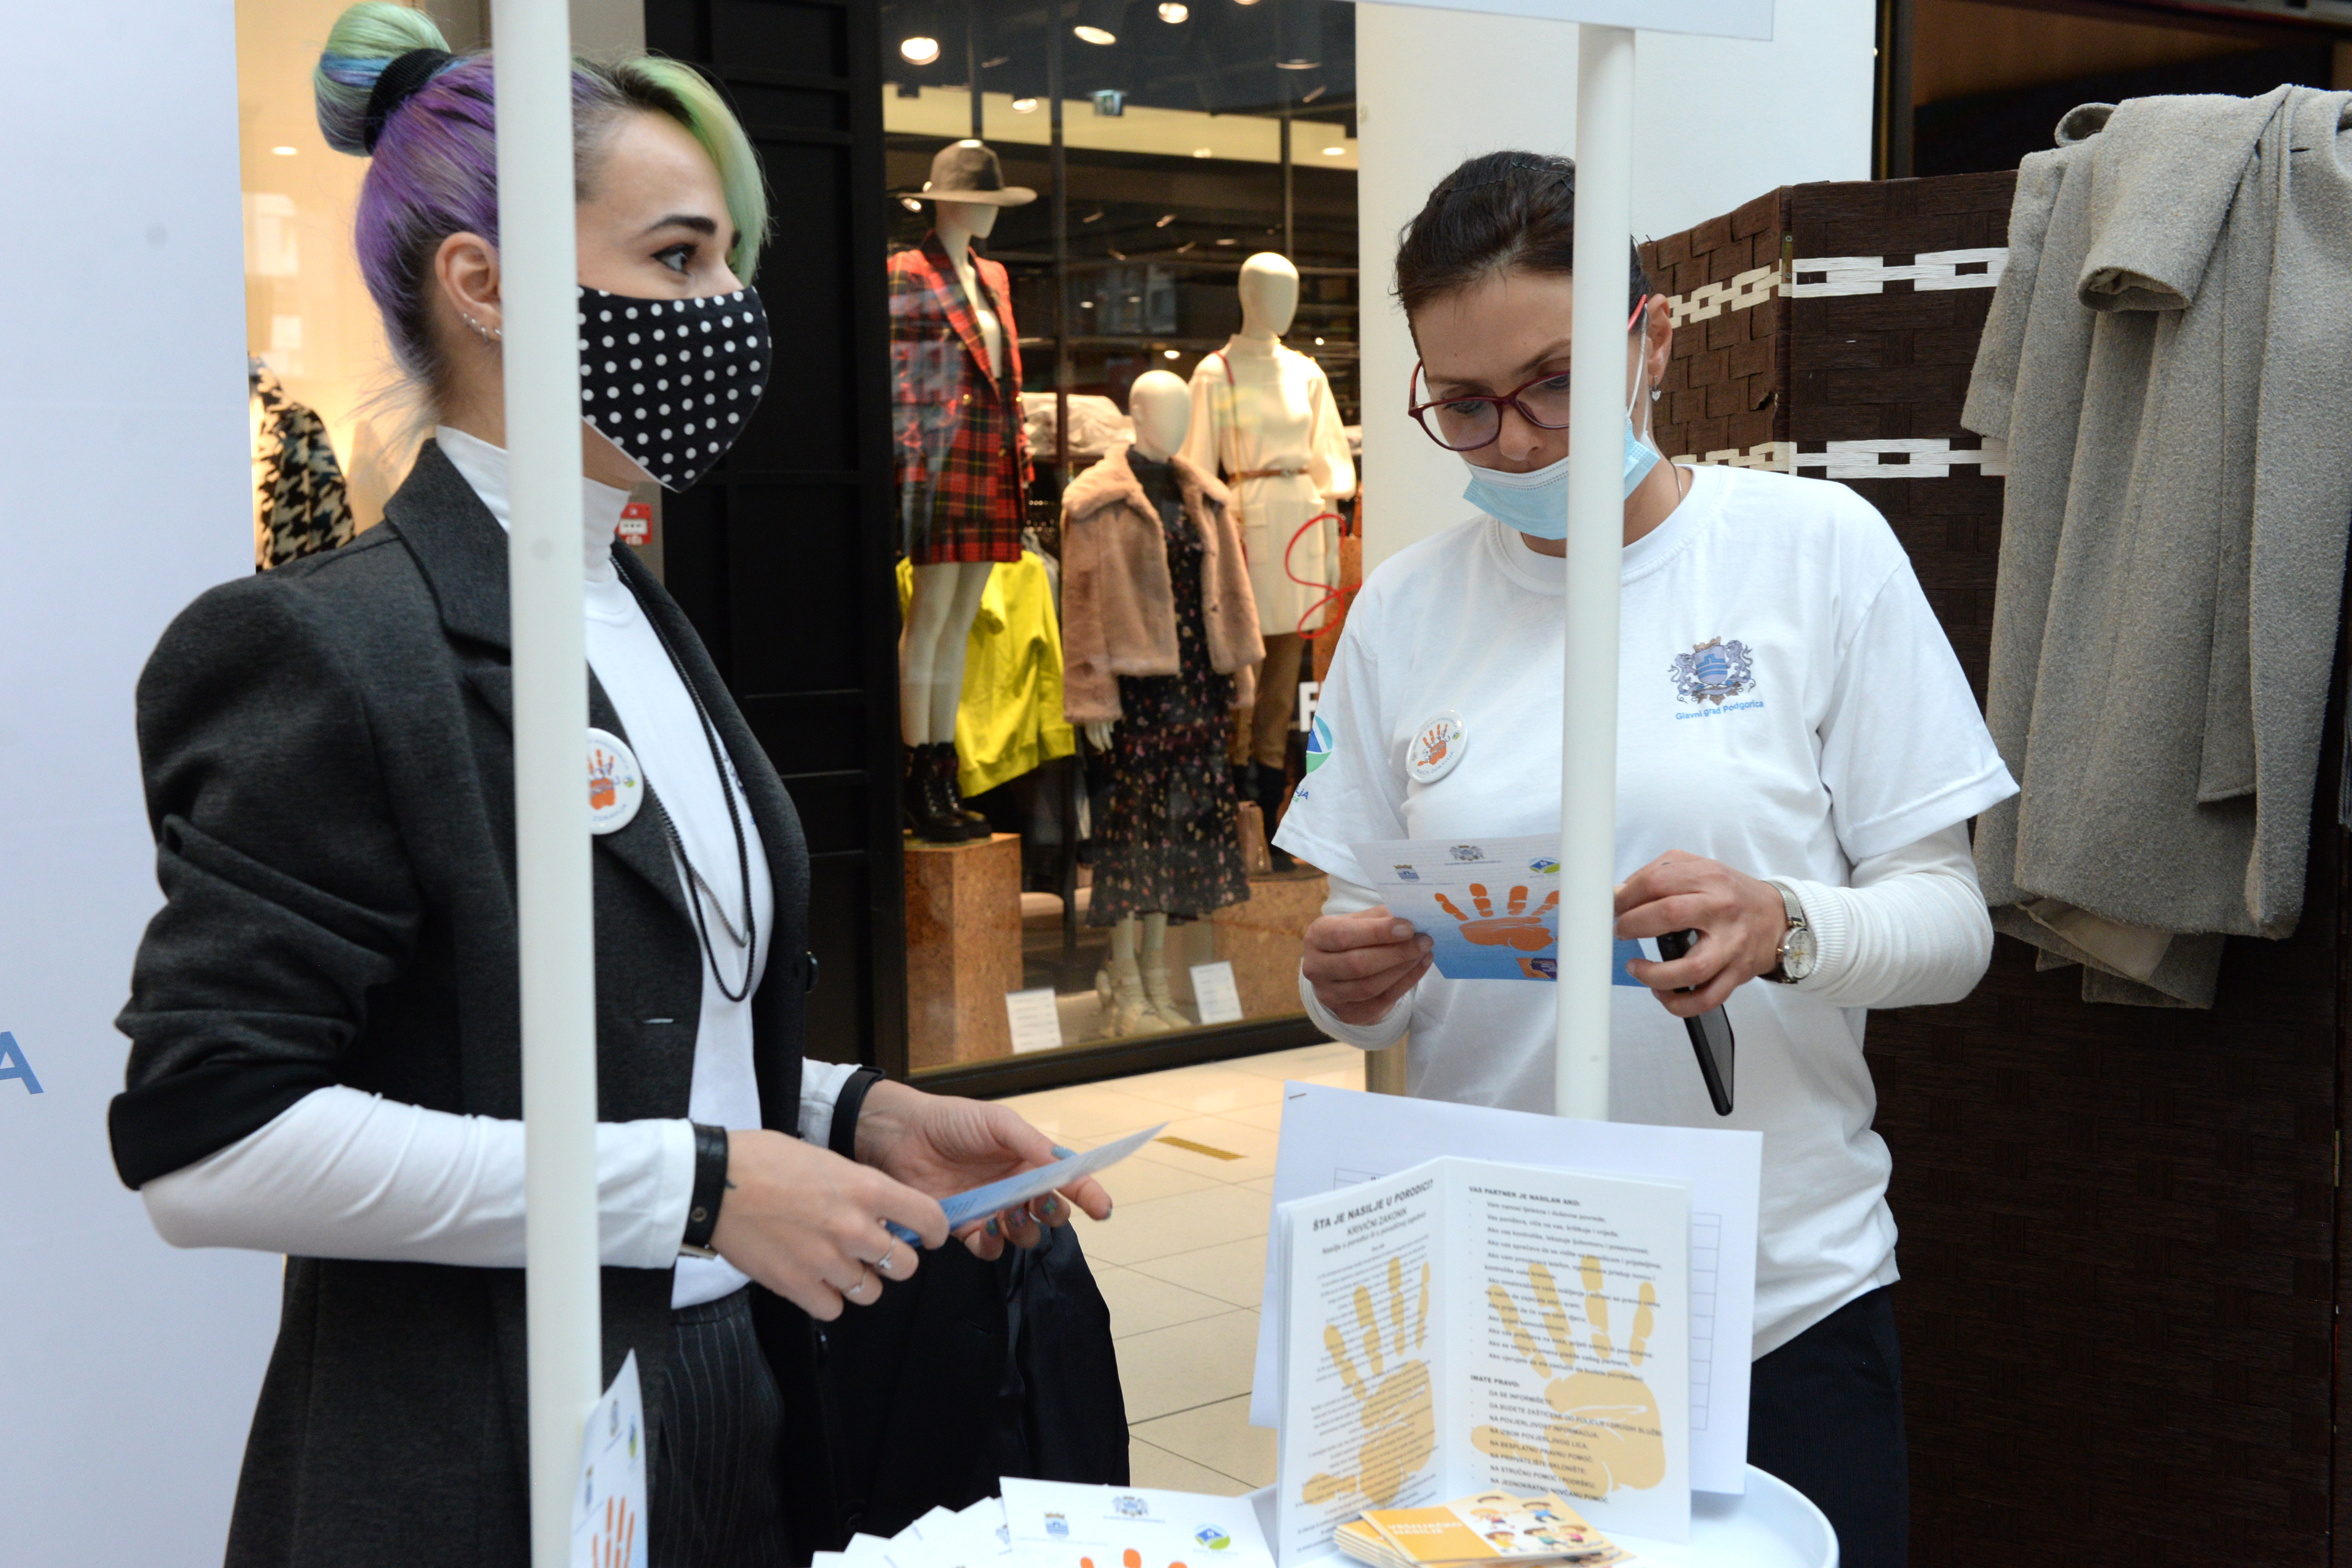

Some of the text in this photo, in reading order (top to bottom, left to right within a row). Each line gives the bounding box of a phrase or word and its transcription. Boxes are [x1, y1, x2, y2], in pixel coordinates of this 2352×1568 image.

[1676, 700, 1765, 720] Glavni grad Podgorica
[1485, 1188, 1517, 1198] PARTNER
[1529, 1194, 1561, 1204] NASILAN
[1313, 1217, 1331, 1231] ŠTA
[1334, 1212, 1345, 1225] JE
[1348, 1198, 1384, 1220] NASILJE
[1347, 1208, 1407, 1235] KRIVIČNI ZAKONIK
[1470, 1374, 1521, 1388] IMATE PRAVO:
